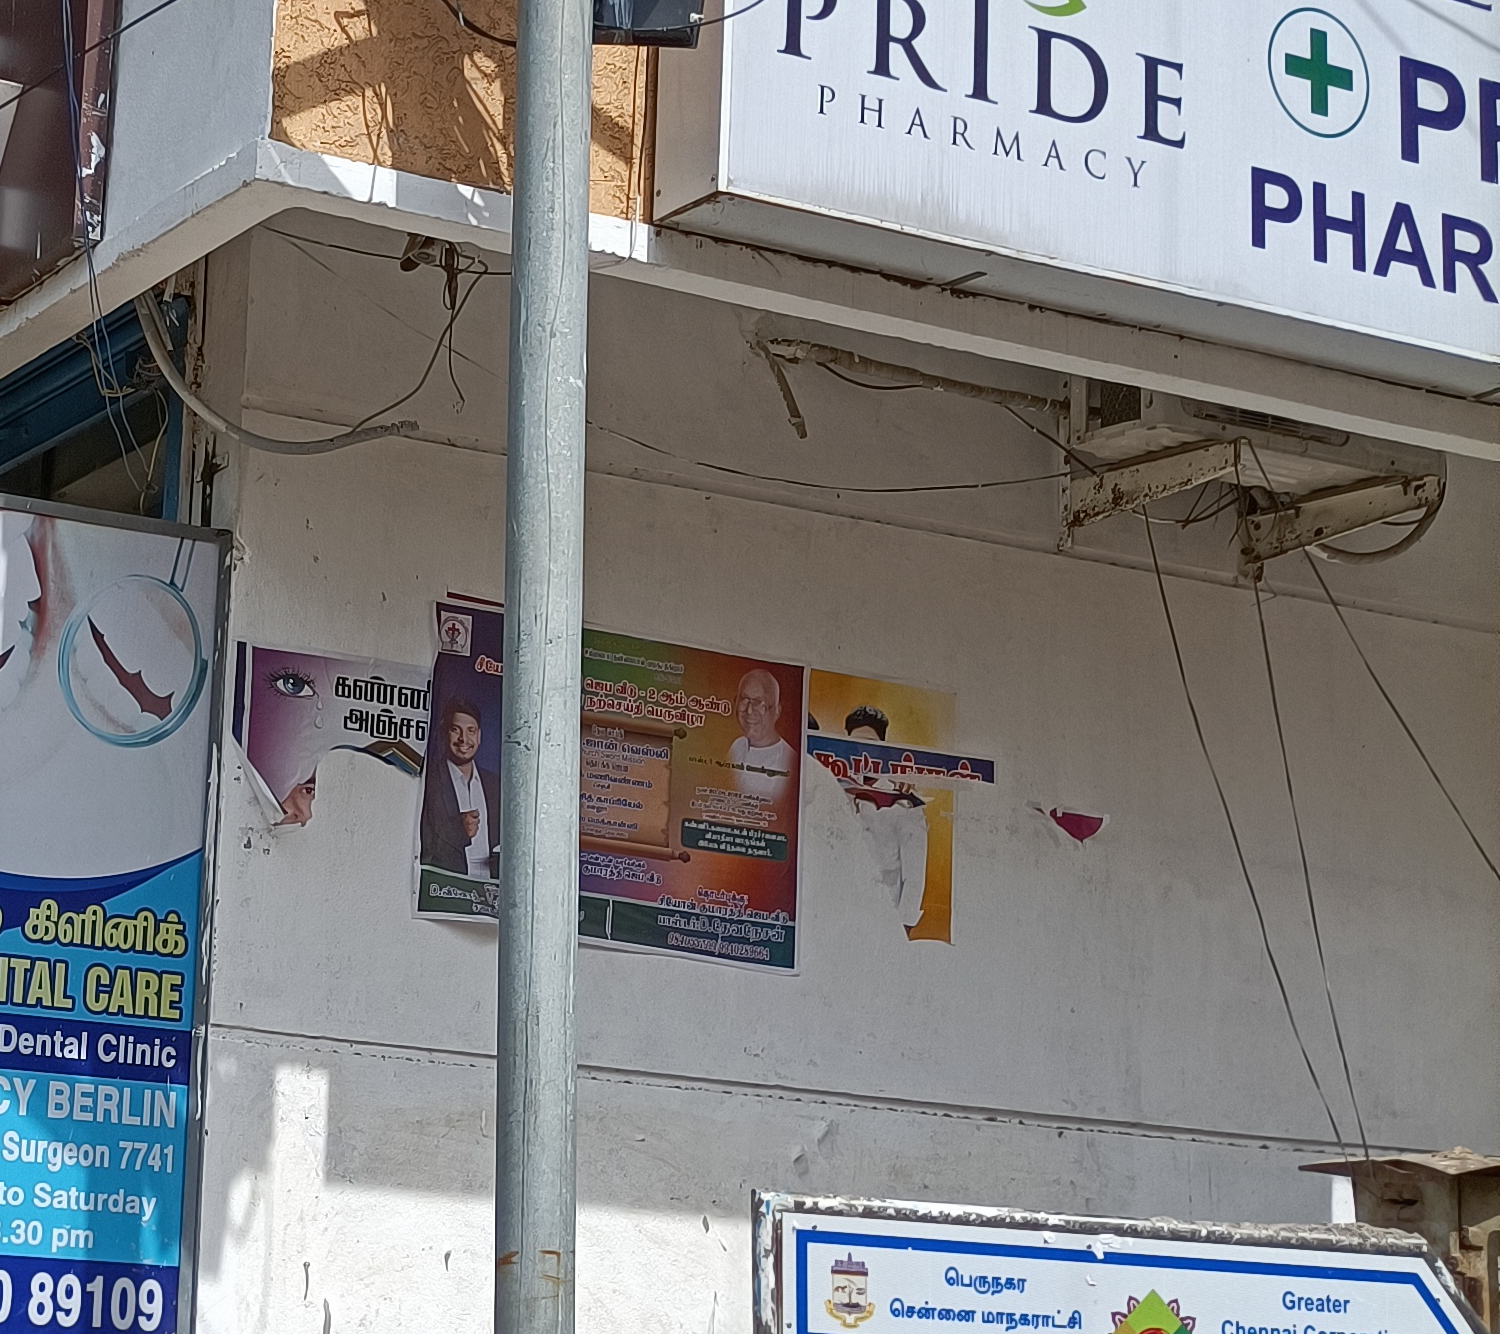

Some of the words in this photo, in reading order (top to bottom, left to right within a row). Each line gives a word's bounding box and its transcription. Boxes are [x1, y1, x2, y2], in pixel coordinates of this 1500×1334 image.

[817, 84, 1147, 189] PHARMACY
[24, 900, 186, 957] கிளினிக்
[87, 966, 182, 1019] CARE
[97, 1033, 177, 1069] Clinic
[47, 1080, 176, 1129] BERLIN
[2, 1131, 110, 1172] Surgeon
[119, 1141, 174, 1174] 7741
[33, 1182, 157, 1223] Saturday
[51, 1226, 94, 1254] pm
[944, 1267, 1027, 1294] பெருநகர
[28, 1274, 163, 1332] 89109
[889, 1298, 978, 1324] சென்னை
[981, 1305, 1083, 1332] மாநகராட்சி
[1281, 1289, 1351, 1317] Greater
